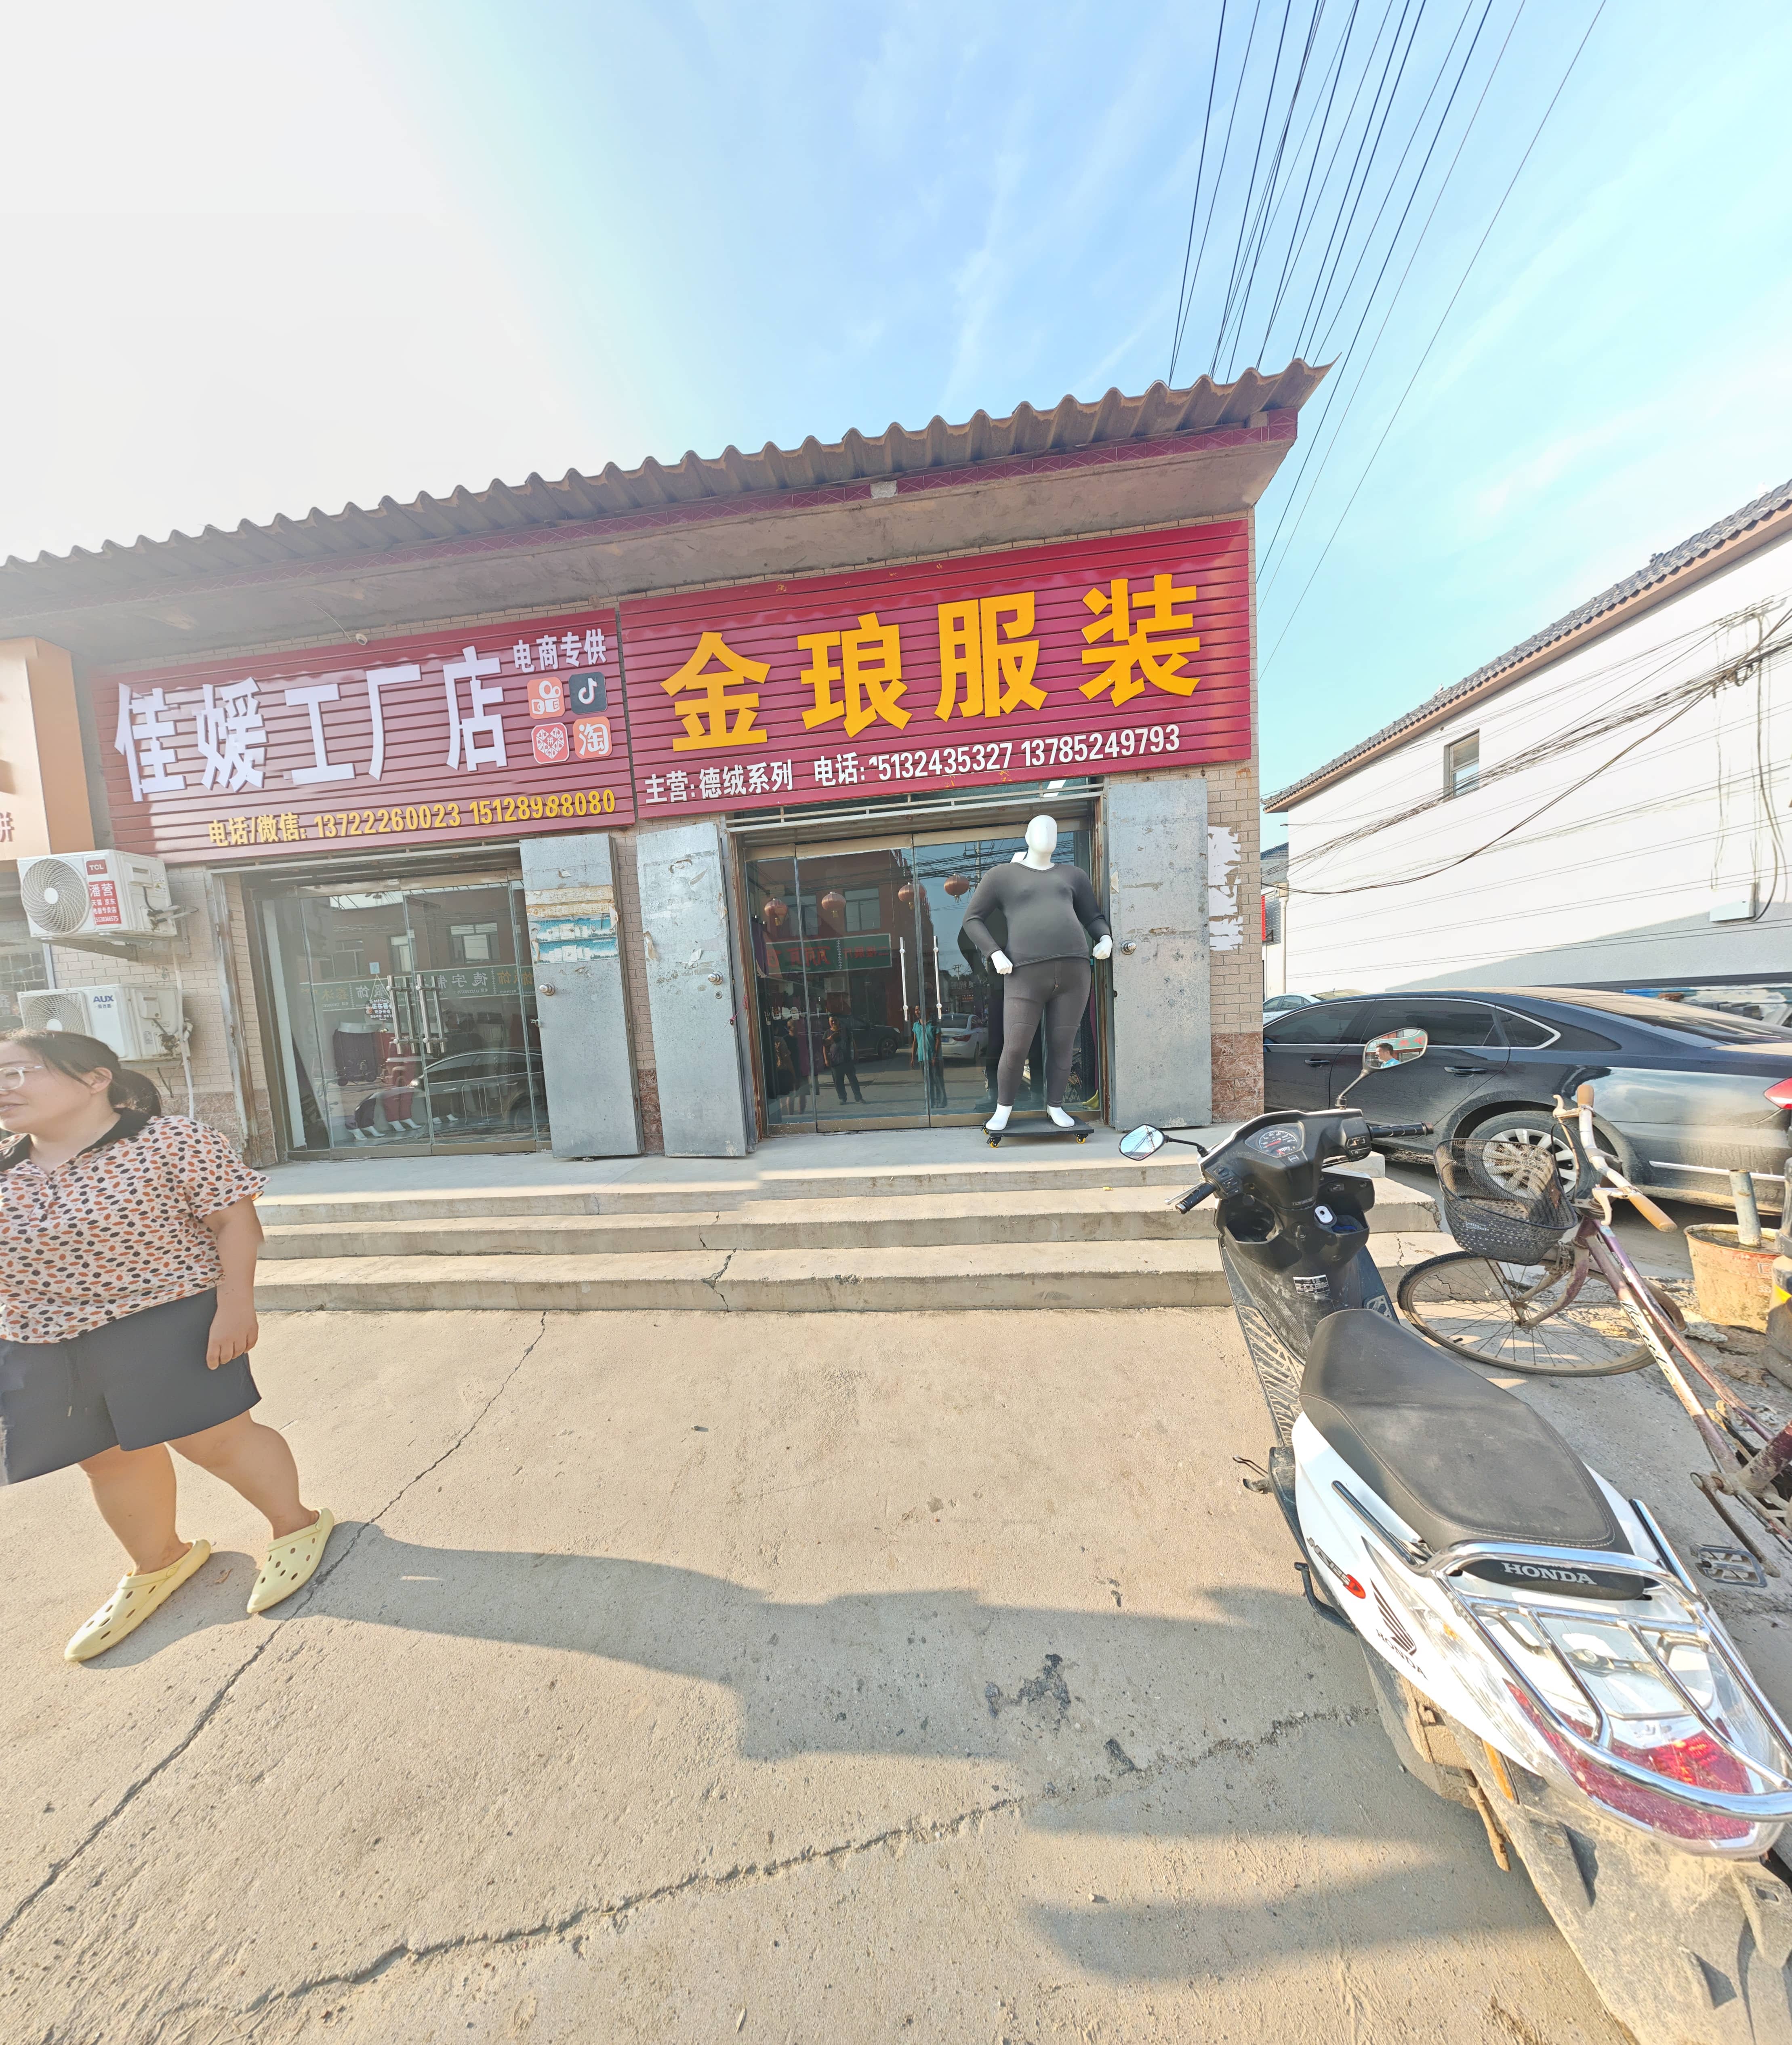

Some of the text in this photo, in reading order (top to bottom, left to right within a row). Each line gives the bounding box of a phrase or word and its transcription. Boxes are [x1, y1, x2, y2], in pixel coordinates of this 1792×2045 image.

[513, 628, 607, 673] 电商专供
[660, 574, 1201, 752] 金琅服装
[114, 645, 508, 802] 佳媛工厂店
[578, 723, 609, 756] 淘
[1021, 724, 1180, 766] 13785249793
[314, 803, 462, 838] 13722260023
[469, 789, 616, 825] 15128988080
[1501, 1562, 1598, 1585] HONDA
[1375, 1628, 1428, 1681] HONDA
